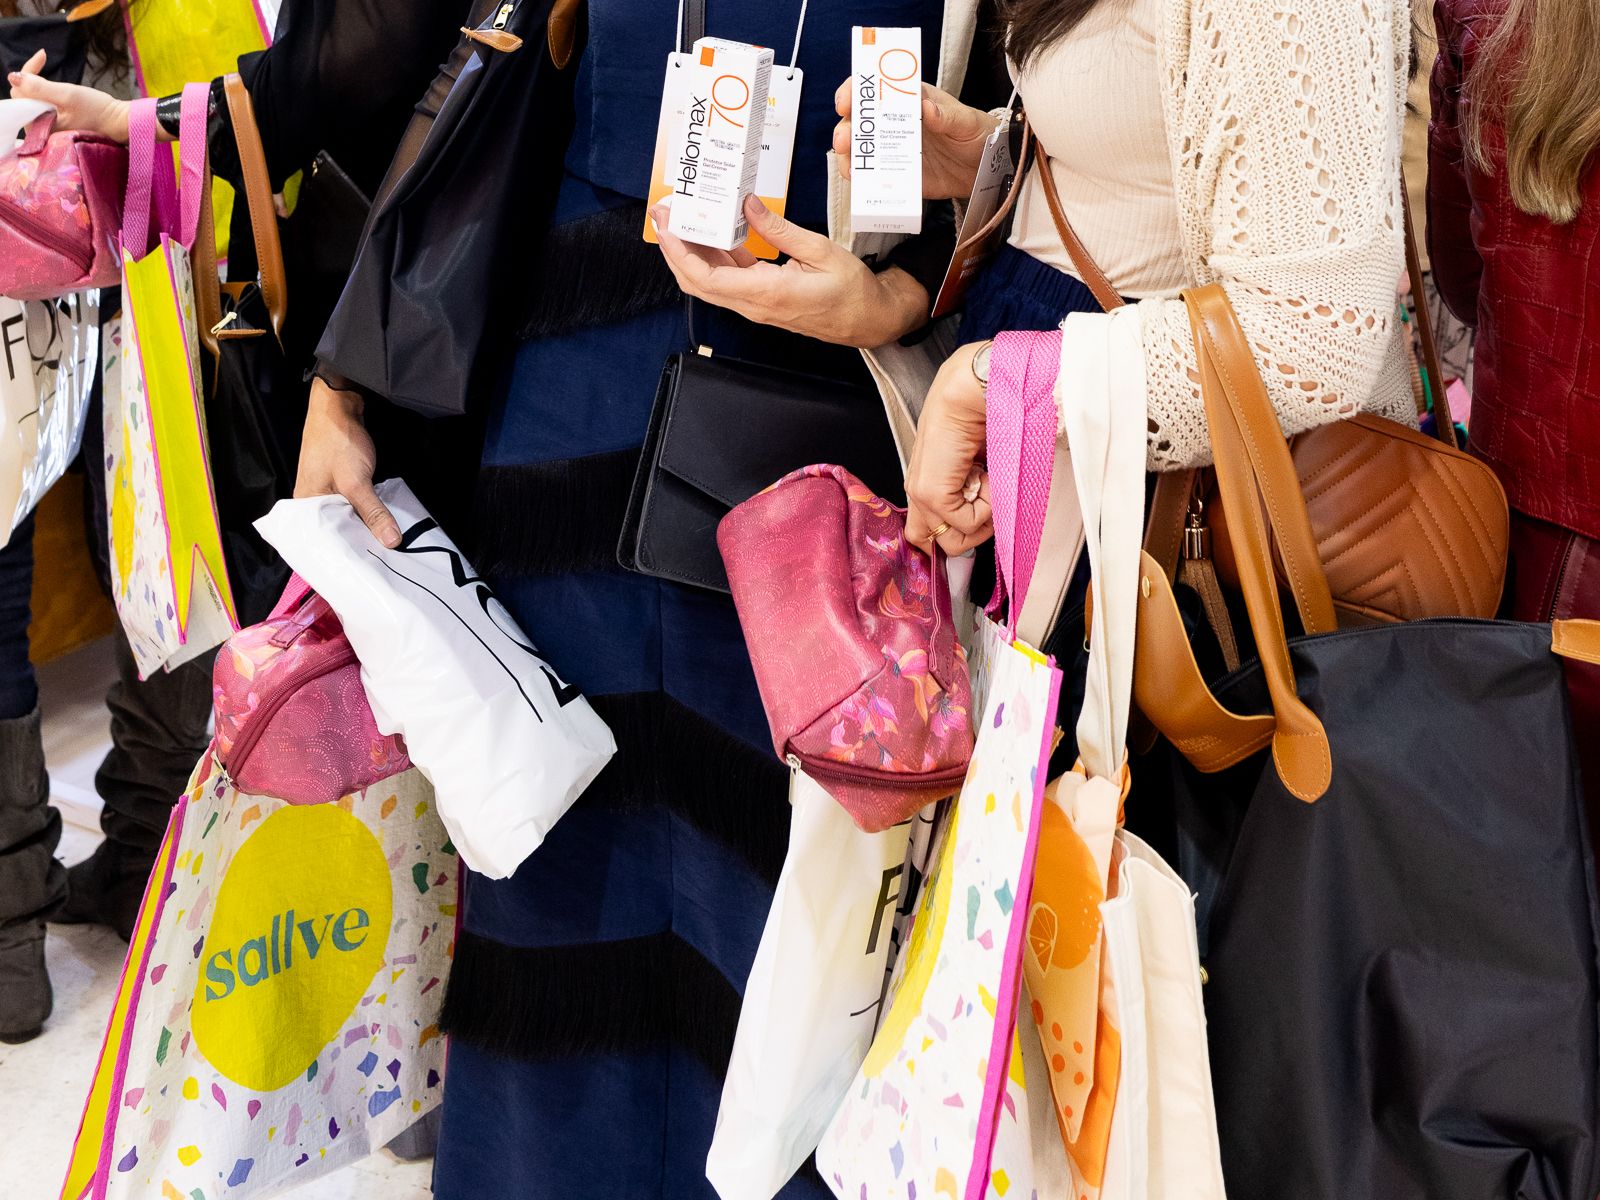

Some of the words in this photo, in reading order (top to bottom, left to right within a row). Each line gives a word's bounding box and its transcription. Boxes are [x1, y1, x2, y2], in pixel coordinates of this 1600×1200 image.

[708, 74, 750, 129] 70
[854, 74, 876, 171] Heliomax
[879, 49, 918, 101] 70
[675, 95, 708, 197] Heliomax
[205, 907, 370, 1004] sallve
